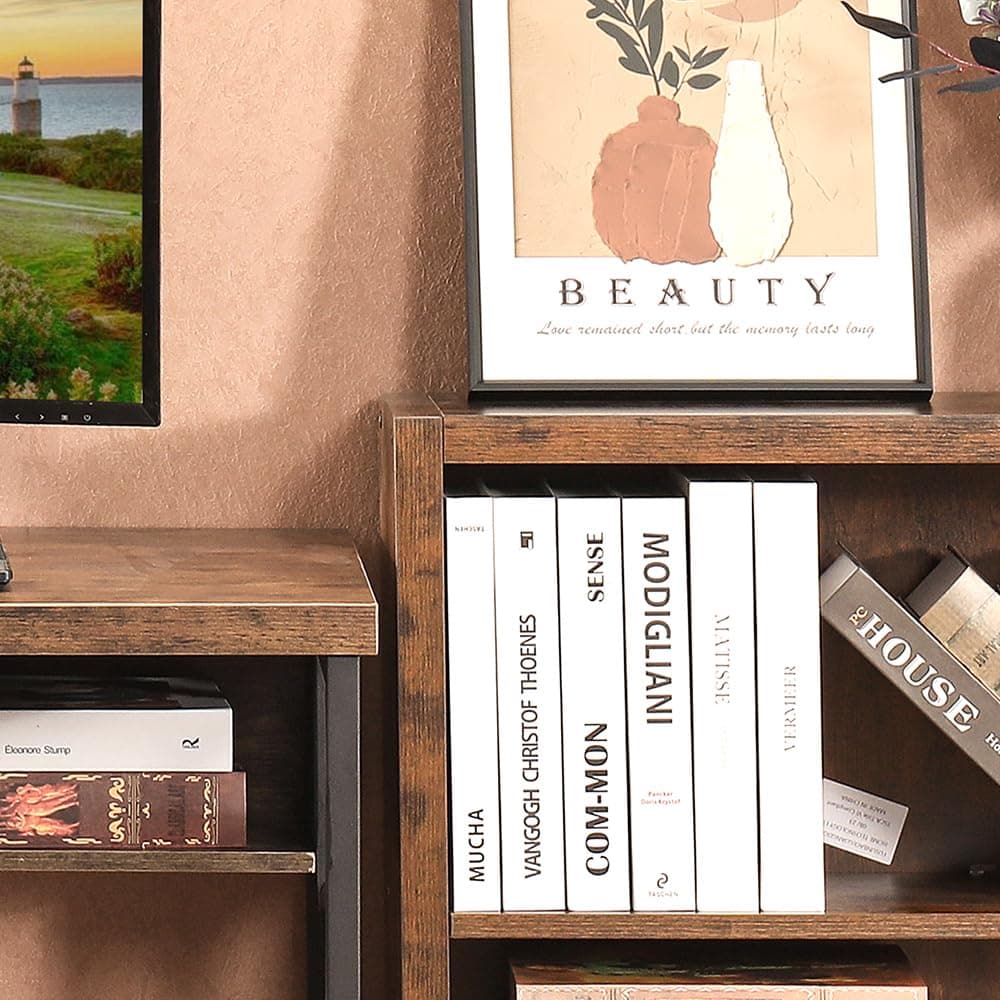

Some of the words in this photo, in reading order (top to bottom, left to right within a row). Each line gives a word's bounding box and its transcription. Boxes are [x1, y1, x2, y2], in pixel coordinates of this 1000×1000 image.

[537, 321, 571, 335] Love
[578, 323, 643, 335] remained
[649, 321, 684, 335] short
[691, 321, 713, 335] but
[719, 321, 739, 335] the
[746, 325, 799, 338] memory
[805, 321, 839, 335] lasts
[846, 321, 875, 338] long
[559, 272, 836, 306] BEAUTY
[586, 532, 604, 602] SENSE
[519, 614, 537, 694] THOENES
[643, 533, 673, 724] MODIGLIANI
[714, 615, 730, 704] MATISSE
[855, 613, 980, 733] HOUSE
[43, 745, 71, 757] Stump
[521, 699, 539, 782] CHRISTOF
[523, 789, 541, 879] VANGOGH
[584, 723, 610, 876] COM-MON
[468, 809, 485, 882] MUCHA
